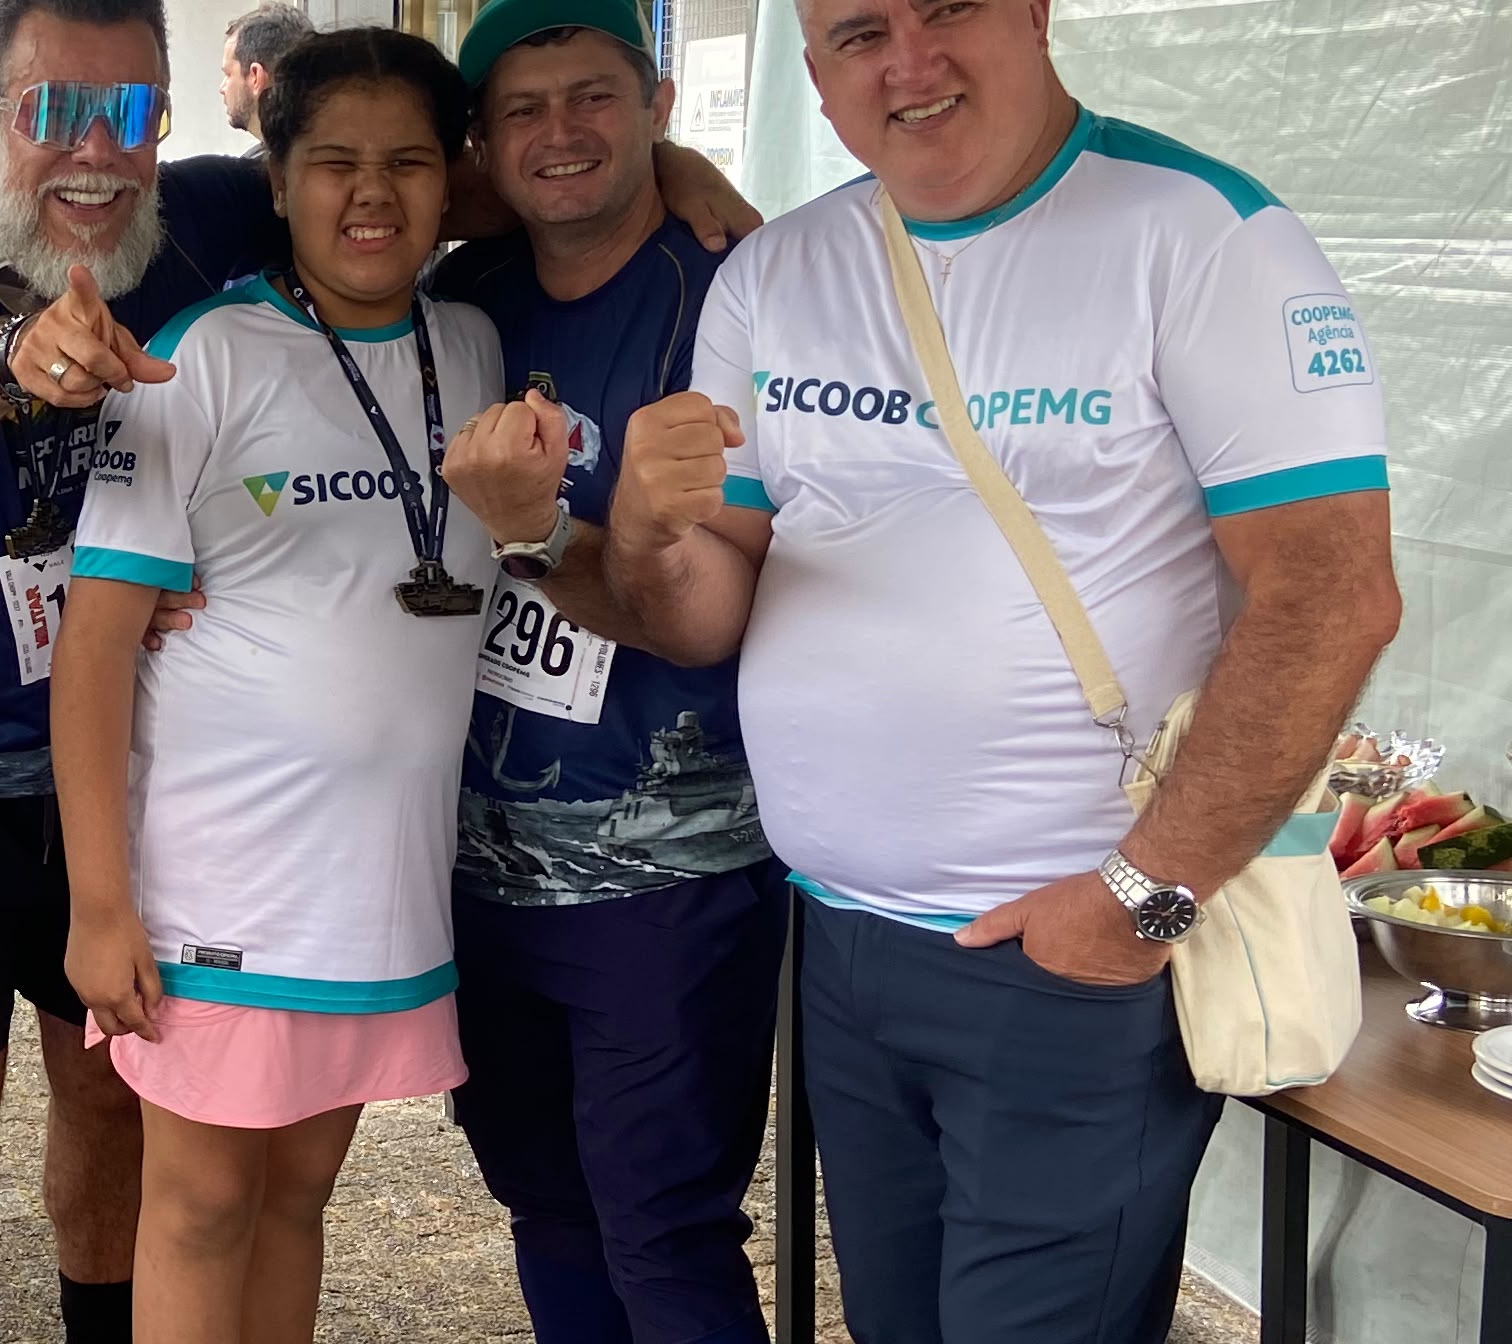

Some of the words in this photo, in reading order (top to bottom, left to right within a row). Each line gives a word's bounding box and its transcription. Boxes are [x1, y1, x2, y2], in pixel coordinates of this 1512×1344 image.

[1308, 325, 1354, 345] Agência
[1307, 348, 1366, 377] 4262
[765, 377, 912, 425] SICOOB
[915, 388, 1112, 431] COPEMG
[25, 584, 50, 650] MILITAR
[484, 586, 579, 677] 296
